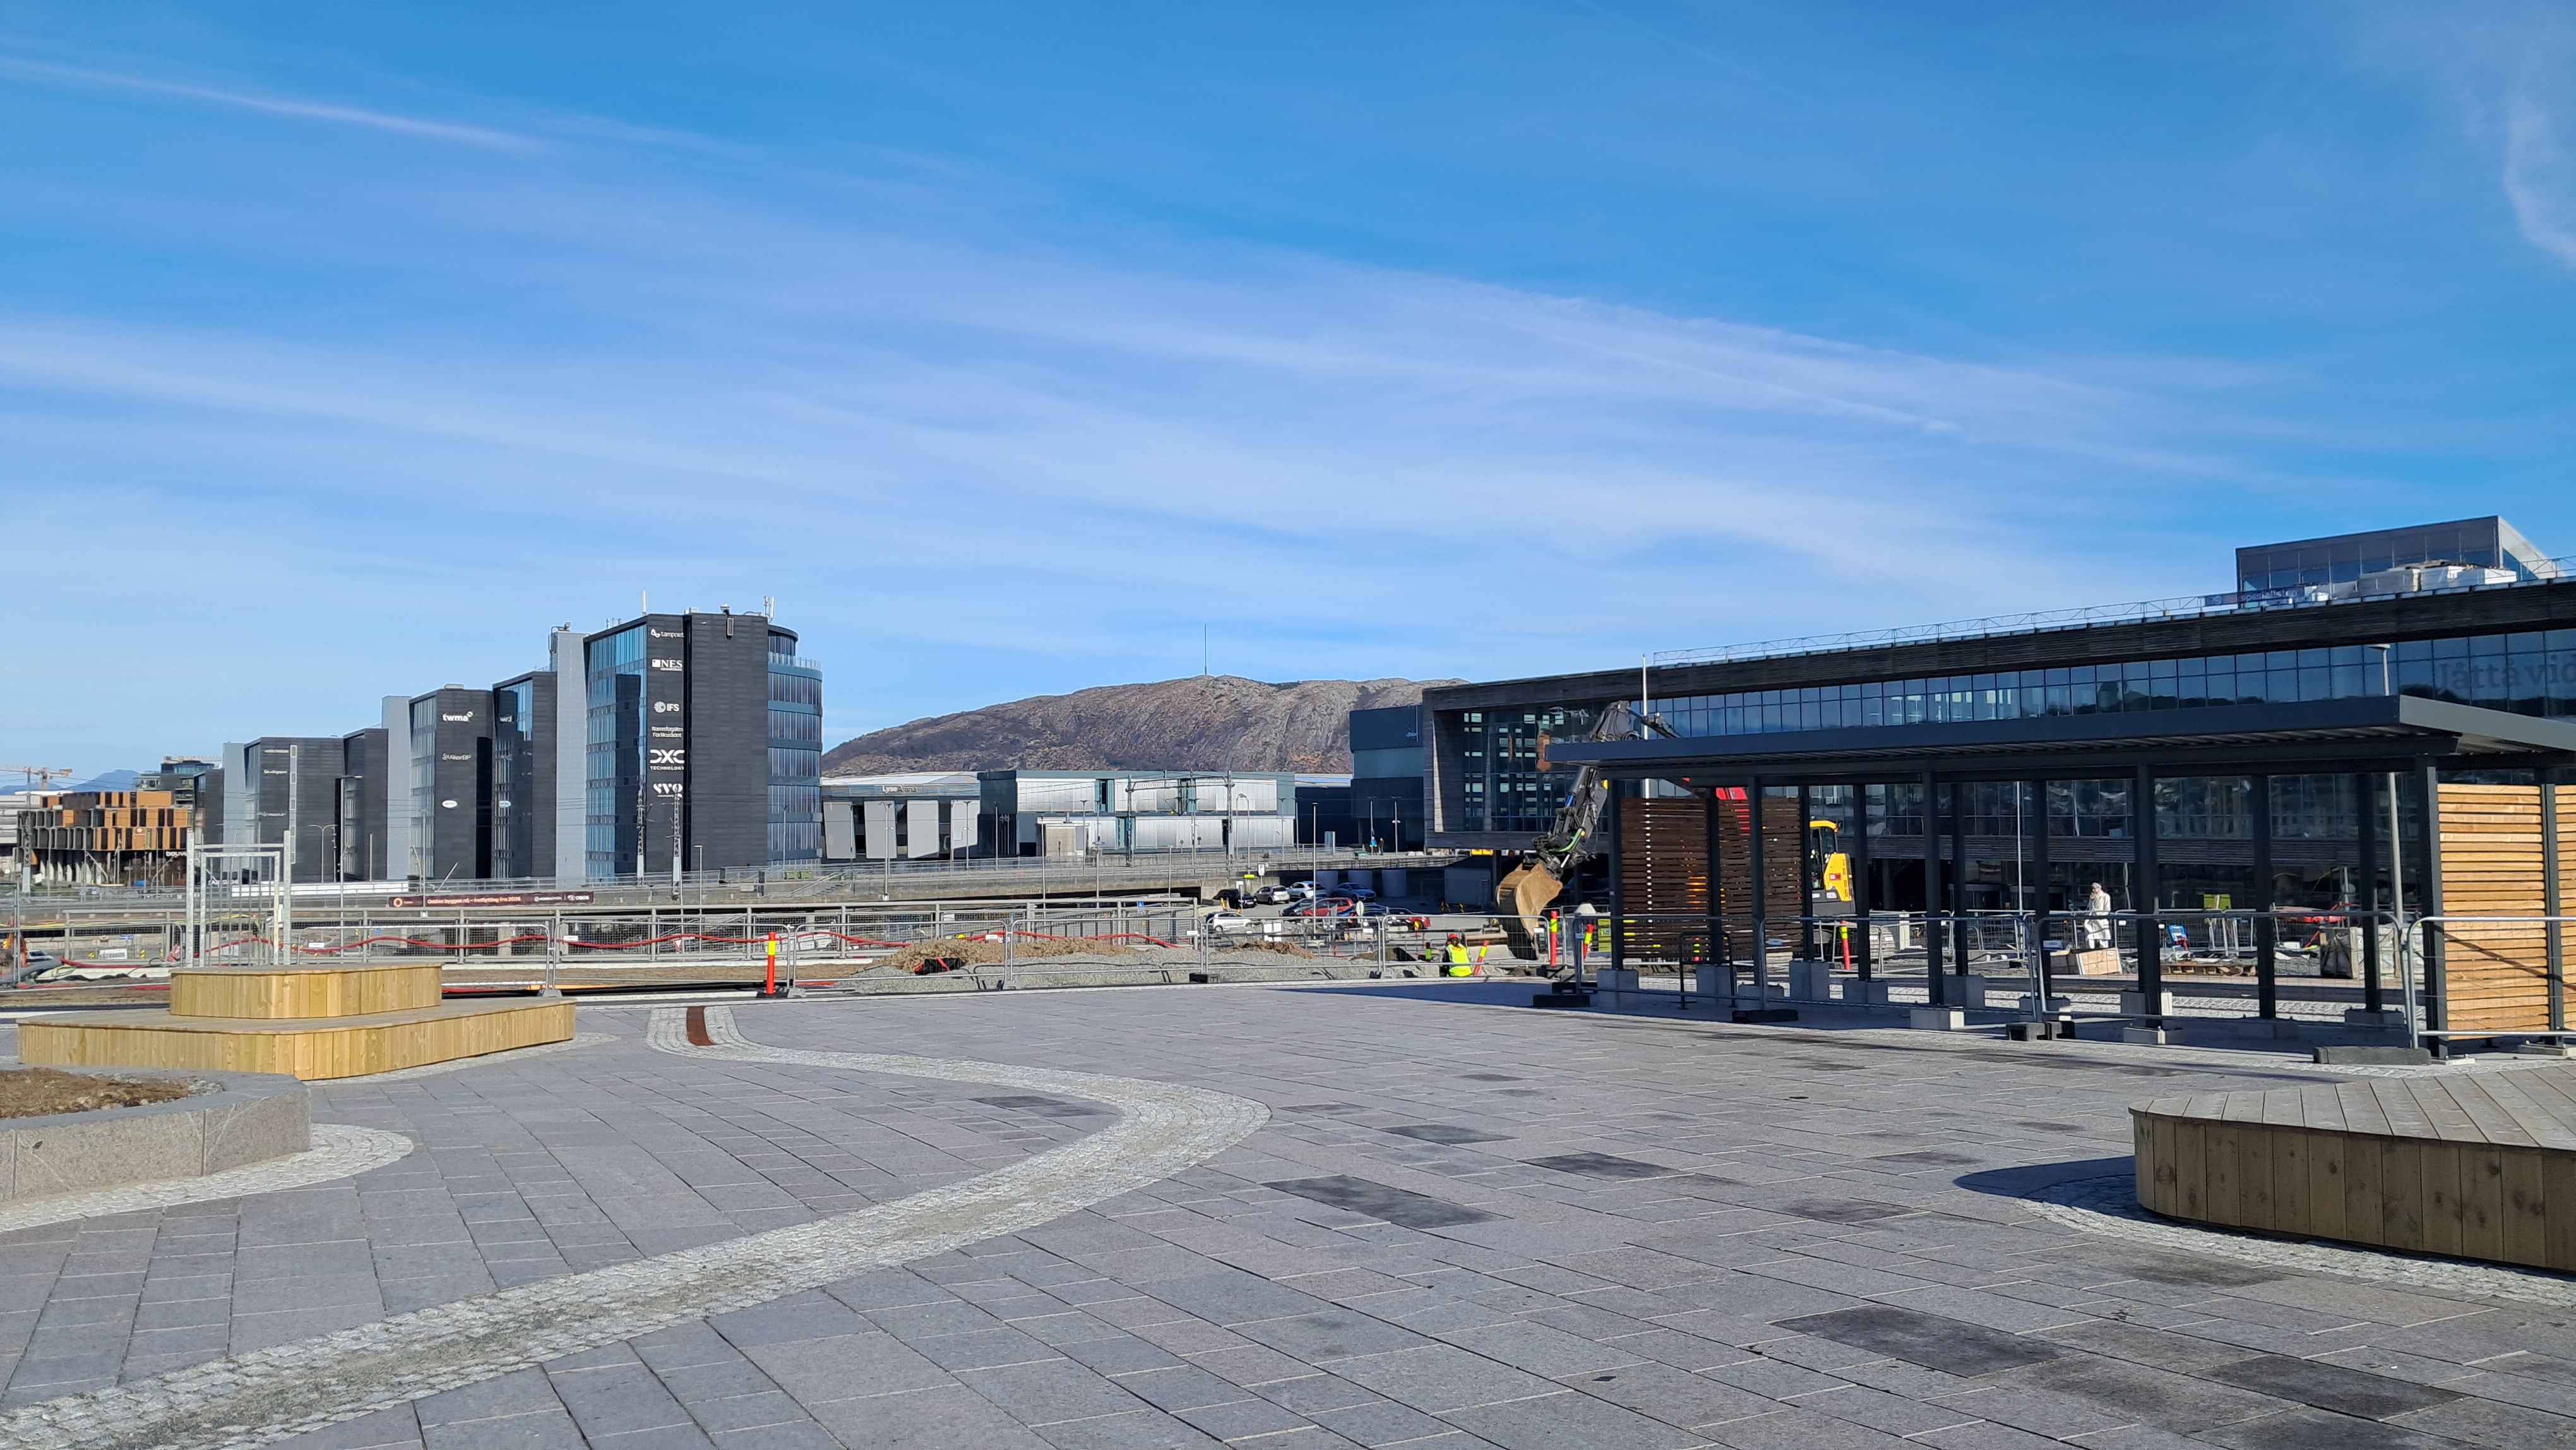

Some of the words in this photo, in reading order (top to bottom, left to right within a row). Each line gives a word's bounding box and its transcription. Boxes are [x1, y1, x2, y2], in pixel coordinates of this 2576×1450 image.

[661, 660, 683, 668] NES
[667, 704, 679, 712] IFS
[650, 750, 685, 764] DXC
